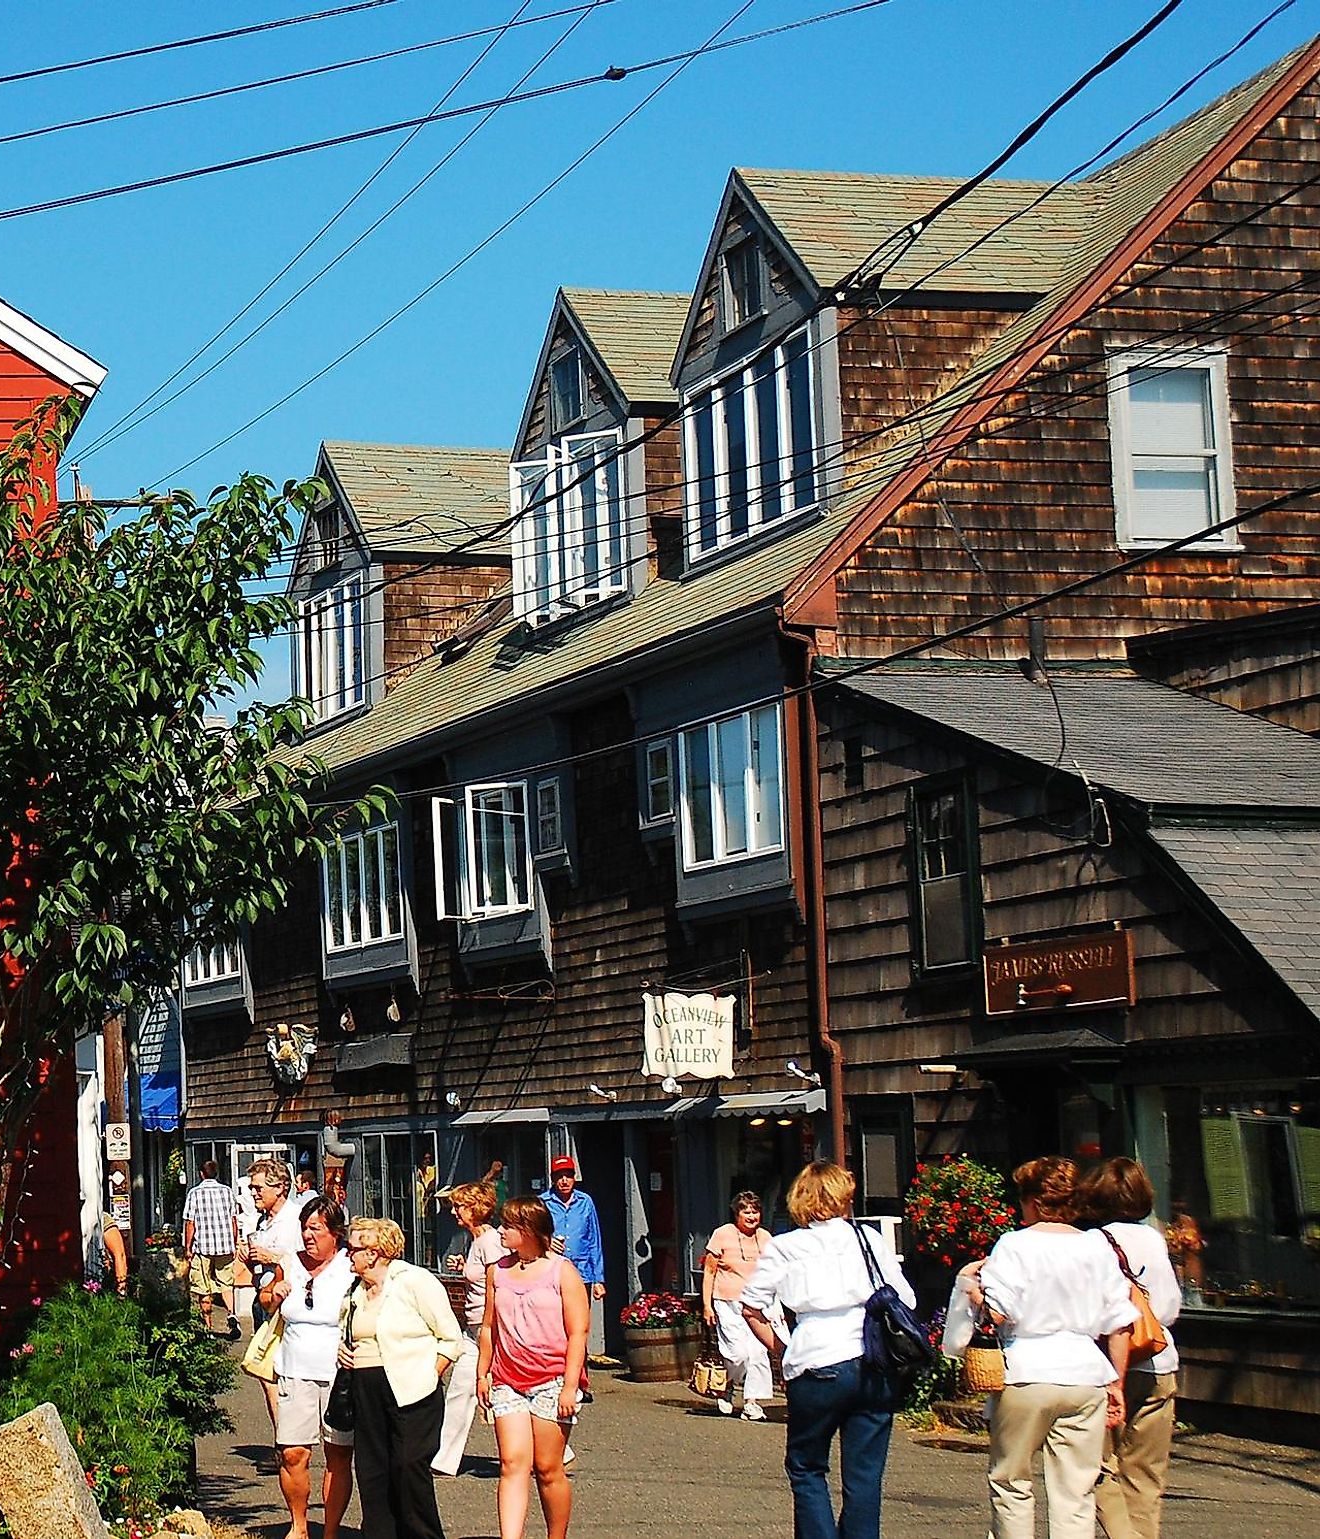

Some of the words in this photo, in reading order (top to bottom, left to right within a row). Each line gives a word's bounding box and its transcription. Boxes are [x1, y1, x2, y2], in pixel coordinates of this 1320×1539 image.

[653, 1005, 728, 1029] OCEANVIEW
[671, 1028, 706, 1044] ART
[654, 1047, 722, 1063] GALLERY
